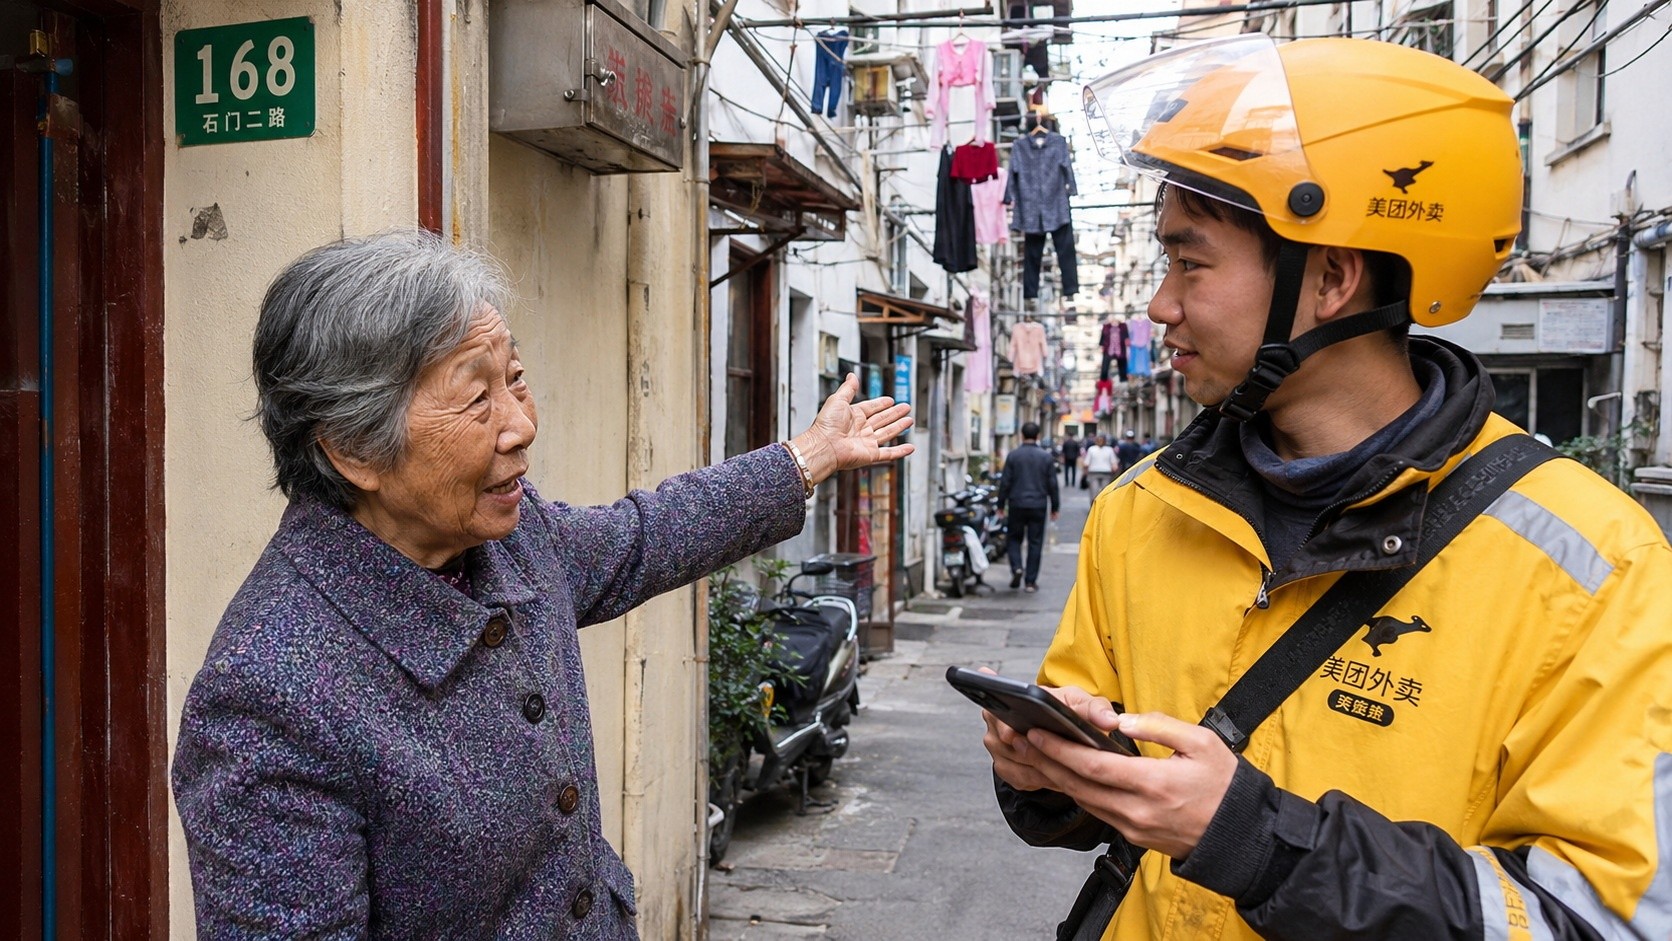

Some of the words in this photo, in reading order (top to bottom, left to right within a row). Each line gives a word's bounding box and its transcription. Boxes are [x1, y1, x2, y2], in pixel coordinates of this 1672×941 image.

[195, 35, 296, 105] 168
[202, 106, 286, 134] 石门二路
[1365, 196, 1445, 222] 美团外卖
[1319, 655, 1423, 708] 美团外卖
